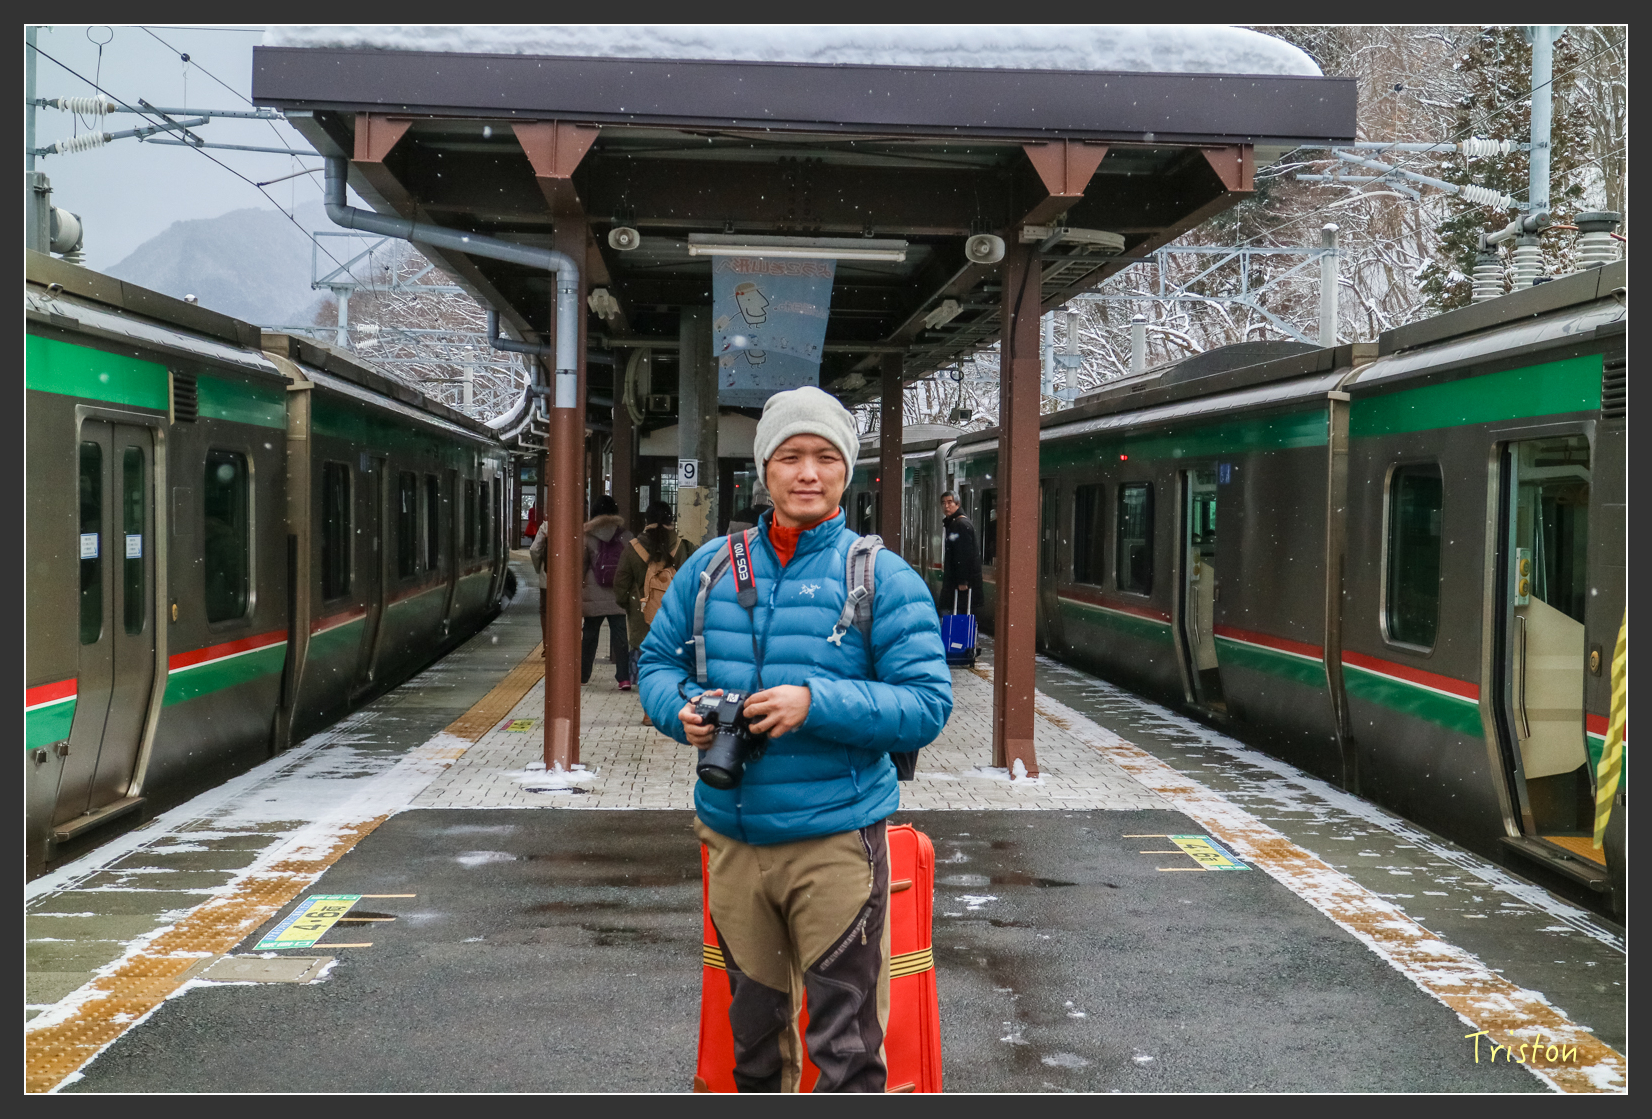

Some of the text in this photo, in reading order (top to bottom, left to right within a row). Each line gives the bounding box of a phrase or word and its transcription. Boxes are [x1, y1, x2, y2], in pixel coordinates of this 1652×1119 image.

[684, 463, 695, 479] 9
[734, 542, 749, 581] EOS 70D
